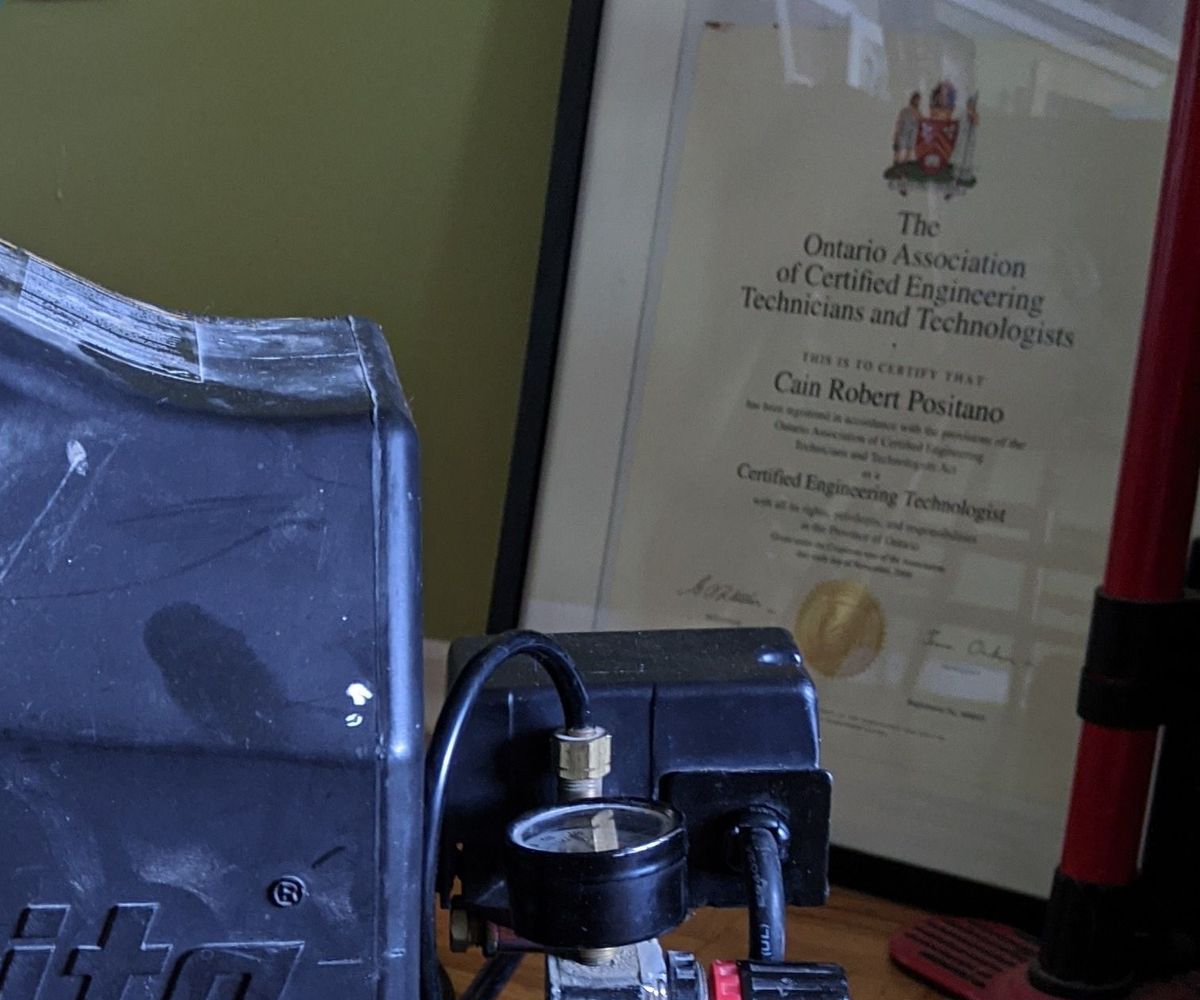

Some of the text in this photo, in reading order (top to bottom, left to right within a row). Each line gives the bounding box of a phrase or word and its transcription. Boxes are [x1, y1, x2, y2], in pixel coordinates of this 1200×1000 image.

[898, 211, 940, 237] The
[803, 233, 1027, 279] Ontario Association
[776, 262, 1045, 318] of Certified Engineering
[741, 286, 1075, 350] Technicians and Technologists
[802, 352, 986, 387] THIS IS TO CERTIFY THAT
[773, 370, 1006, 425] Cain Robert Positano
[736, 462, 802, 490] Certified
[805, 473, 898, 508] Engineering
[903, 488, 1007, 525] Technologist
